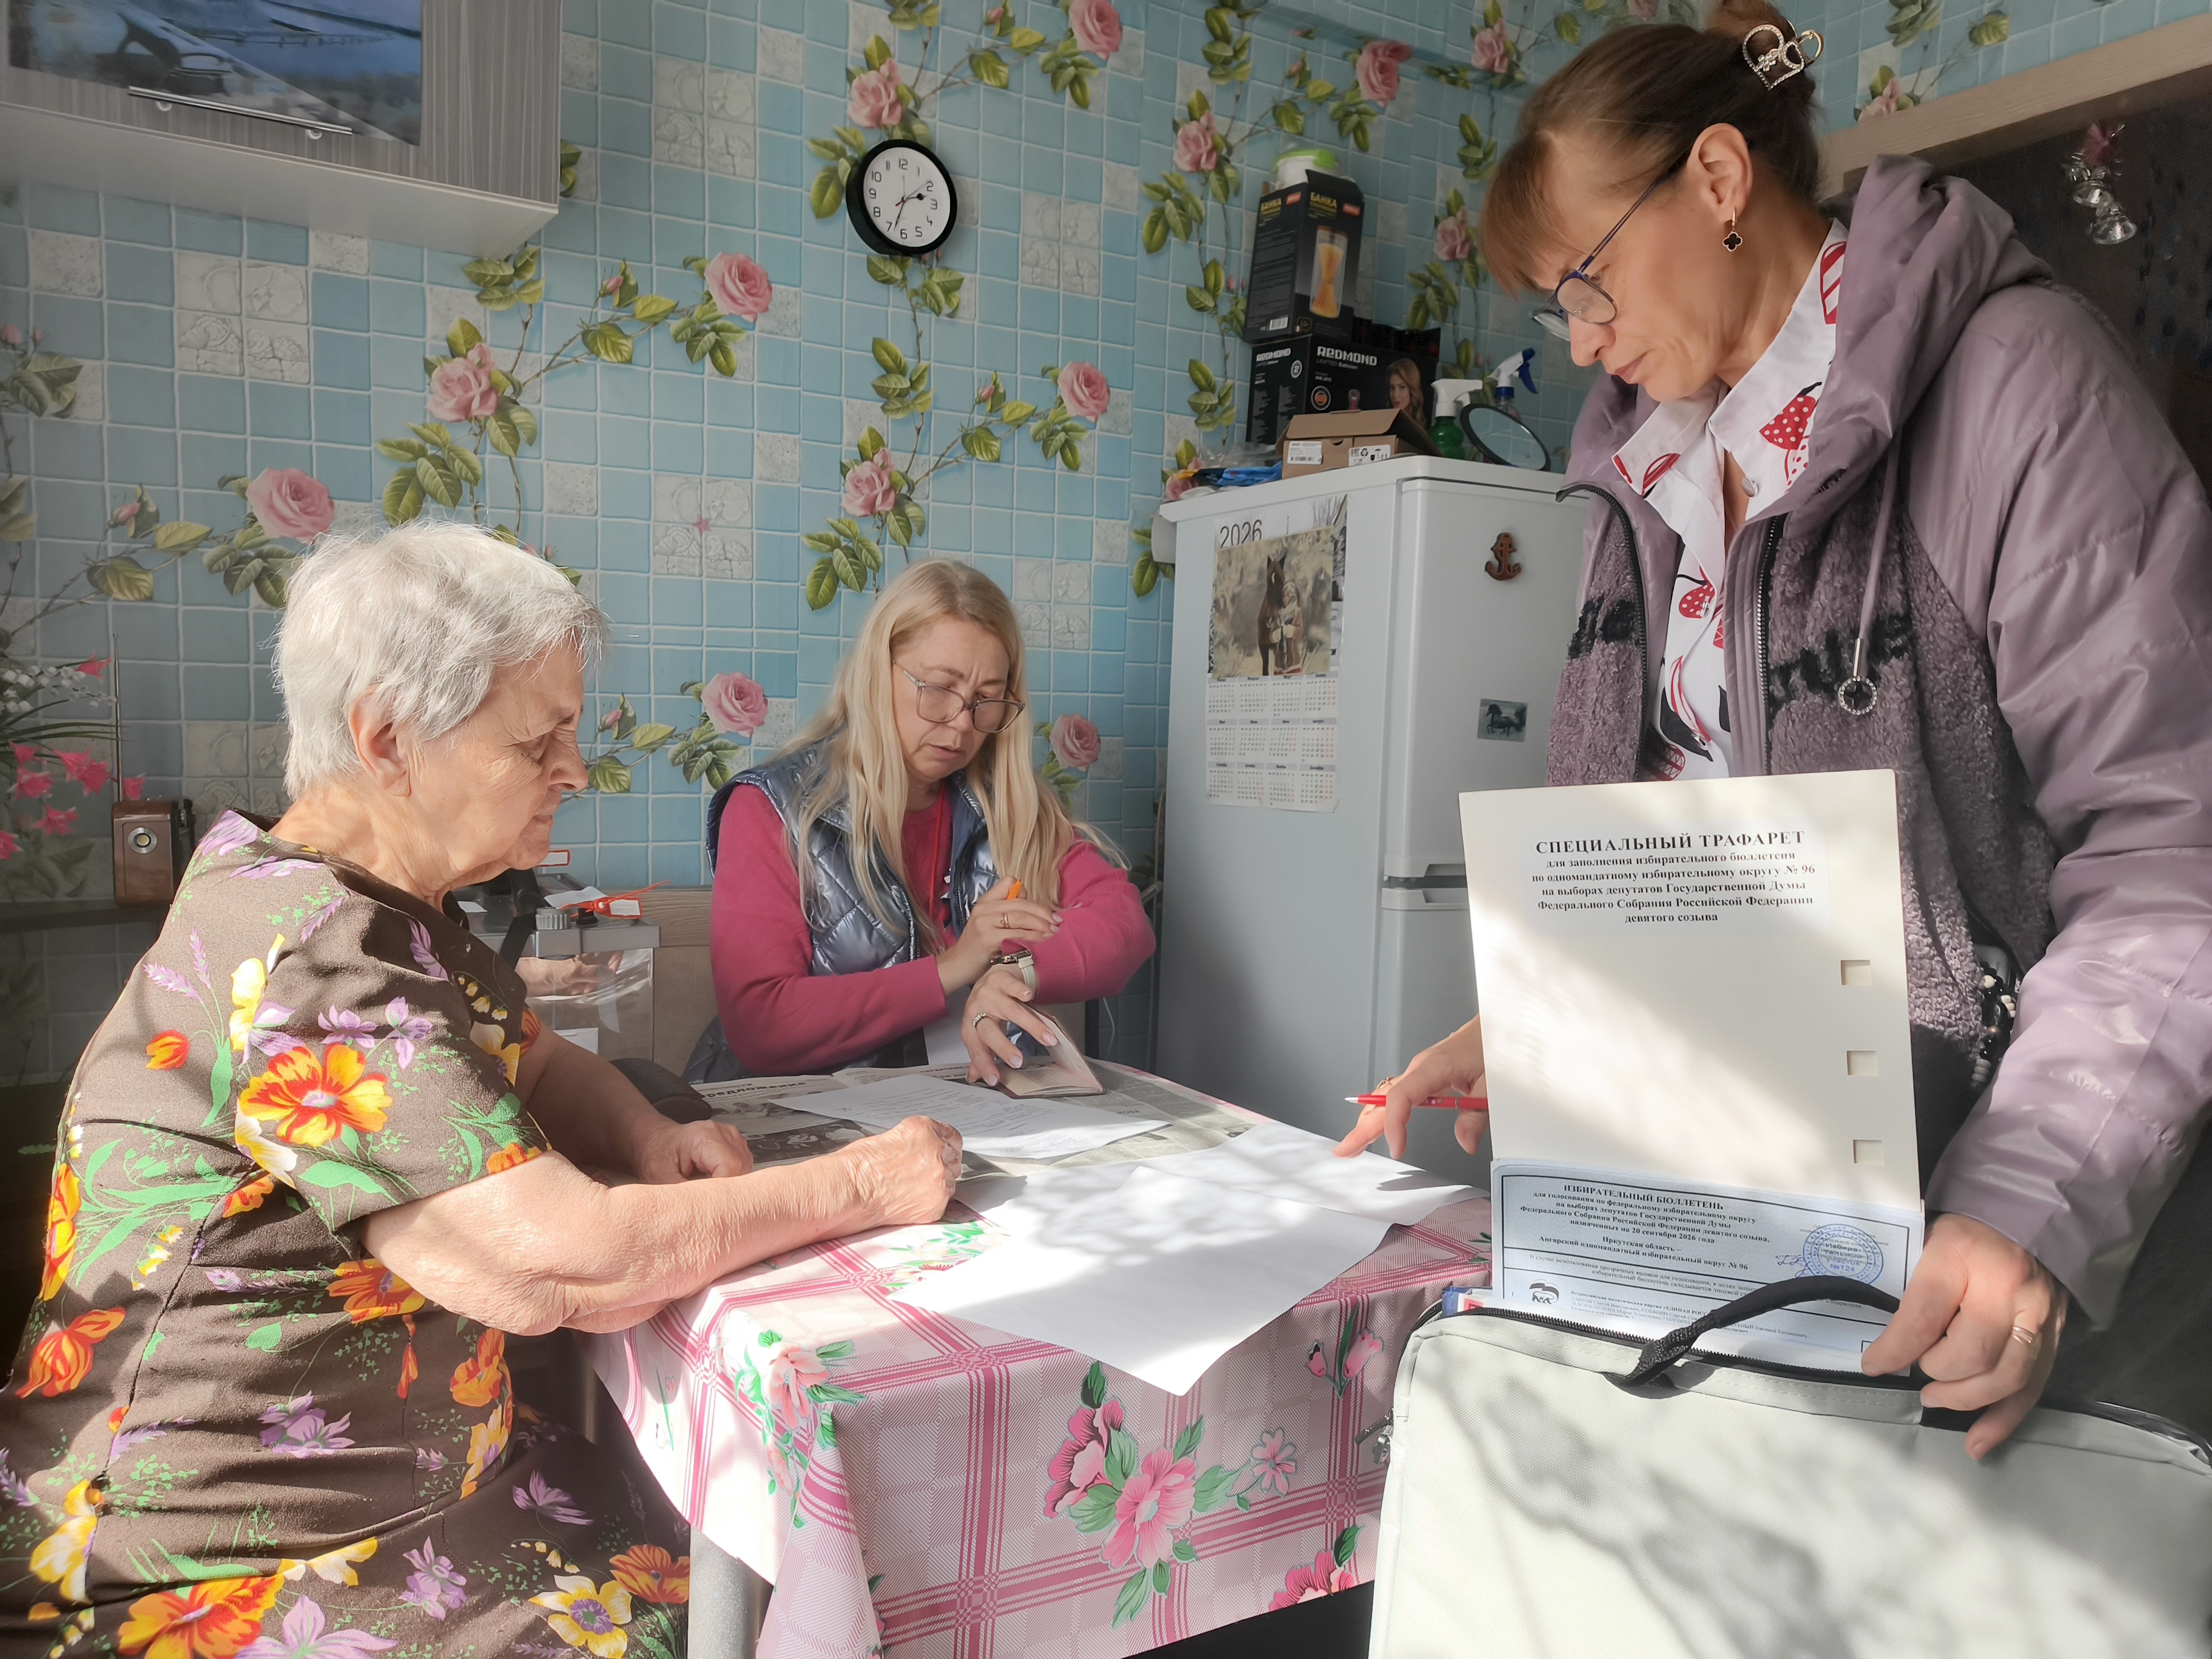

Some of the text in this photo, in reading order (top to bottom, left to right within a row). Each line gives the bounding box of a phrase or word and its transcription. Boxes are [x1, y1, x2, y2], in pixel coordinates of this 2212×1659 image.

[885, 160, 891, 171] 11
[899, 158, 909, 170] 12
[871, 170, 882, 183] 10
[869, 188, 876, 199] 9
[926, 180, 934, 192] 2
[874, 206, 881, 217] 8
[930, 198, 938, 210] 3
[886, 221, 892, 232] 7
[926, 216, 933, 226] 4
[900, 229, 908, 240] 6
[915, 226, 923, 237] 5
[1220, 519, 1263, 548] 2026
[1536, 831, 1804, 855] СПЕЦИАЛЬНЫЙ ТРАФАРЕТ
[1568, 858, 1632, 867] заполнения
[1636, 854, 1726, 866] избирательного
[1730, 852, 1795, 862] бюллетеня
[1548, 872, 1638, 882] одномандатному
[1642, 868, 1735, 880] избирательному
[1739, 868, 1781, 877] округу
[1784, 865, 1798, 875] №
[1802, 864, 1815, 874] 96
[1558, 886, 1603, 897] выборах
[1606, 886, 1663, 896] депутатов
[1666, 881, 1765, 894] Государственной
[1769, 881, 1806, 892] Думы
[1538, 896, 1813, 911] Федерального Собрания Российской Федерации
[1624, 914, 1718, 923] девятого созыва
[704, 1081, 807, 1098] редложение
[1563, 1184, 1724, 1210] ИЗБИРАТЕЛЬНЫЙ БЮЛЛЕТЕНЬ
[1548, 1193, 1594, 1203] голосования
[1607, 1199, 1661, 1212] федеральному
[1663, 1206, 1726, 1220] избирательному
[1729, 1214, 1757, 1224] округу
[1567, 1203, 1598, 1212] выборах
[1600, 1206, 1638, 1217] депутатов
[1640, 1212, 1706, 1225] Государственной
[1707, 1220, 1731, 1229] Думы
[1520, 1206, 1770, 1243] Федерального Собрания Российской Федерации девятого созыва,
[1570, 1220, 1619, 1231] назначенных
[1642, 1230, 1677, 1240] сентября
[1679, 1233, 1696, 1241] 2026
[1602, 1236, 1643, 1248] Иркутская
[1645, 1243, 1675, 1251] область
[1539, 1236, 1579, 1246] Ангарский
[1580, 1241, 1640, 1255] одномандатный
[1642, 1250, 1701, 1264] избирательный
[1704, 1259, 1725, 1268] округ
[1556, 1258, 1598, 1269] использования
[1599, 1265, 1634, 1275] прозрачных
[1672, 1276, 1711, 1286] голосования,
[1592, 1270, 1635, 1281] избирательный
[1637, 1277, 1669, 1286] бюллетень
[1670, 1282, 1712, 1292] складывается
